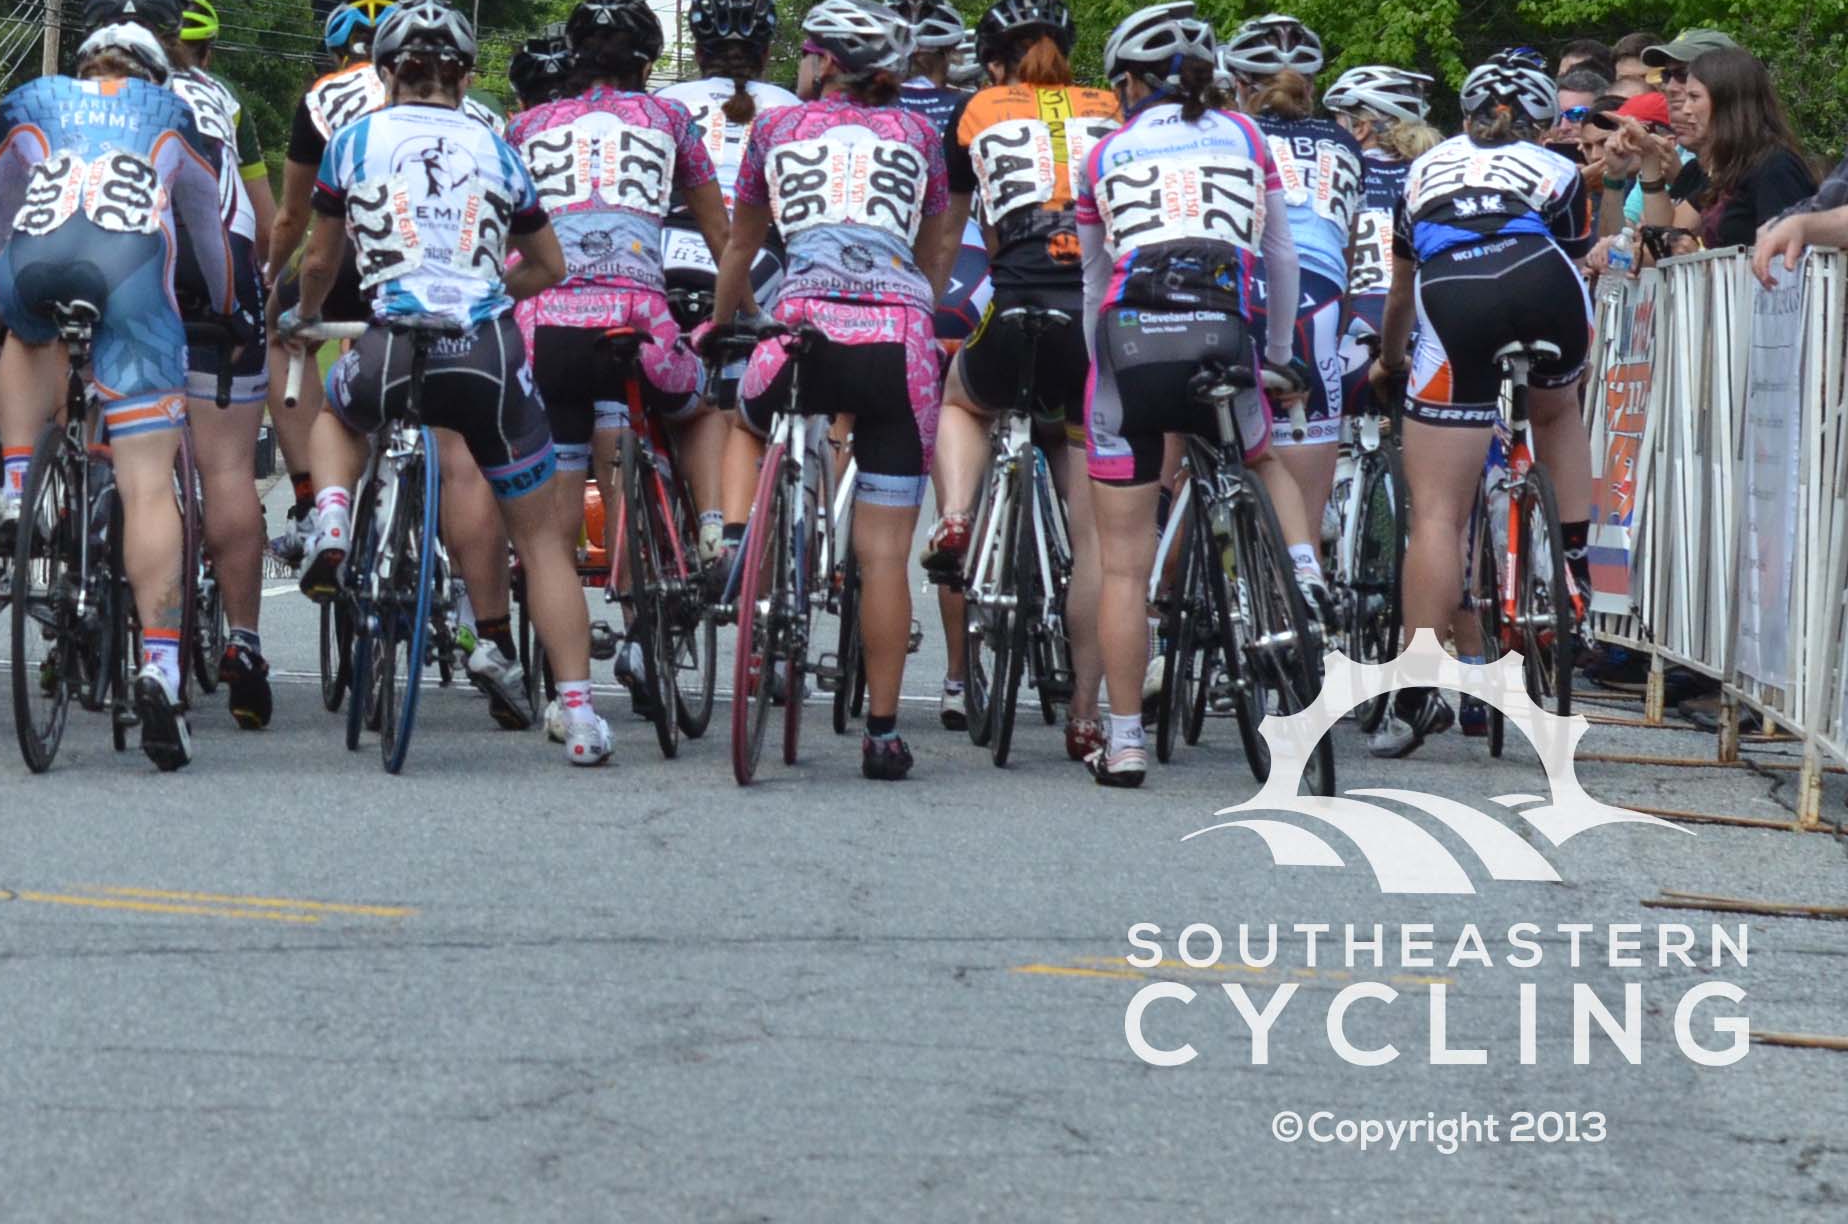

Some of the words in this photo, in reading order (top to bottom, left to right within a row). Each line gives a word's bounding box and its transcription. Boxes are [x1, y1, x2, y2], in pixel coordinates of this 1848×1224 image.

[61, 110, 139, 132] FEMME
[1136, 140, 1199, 157] Cleveland
[1201, 136, 1236, 149] Clinic
[94, 154, 157, 227] 209
[529, 131, 576, 197] 237
[619, 131, 666, 205] 237
[775, 144, 829, 225] 286
[866, 146, 920, 234] 286
[980, 126, 1037, 212] 244
[349, 184, 406, 275] 224
[460, 222, 474, 253] USA
[465, 194, 481, 224] CRITS
[1105, 165, 1165, 248] 271
[1199, 165, 1255, 244] 271
[1139, 312, 1194, 324] Cleveland
[1195, 310, 1227, 322] Clinic
